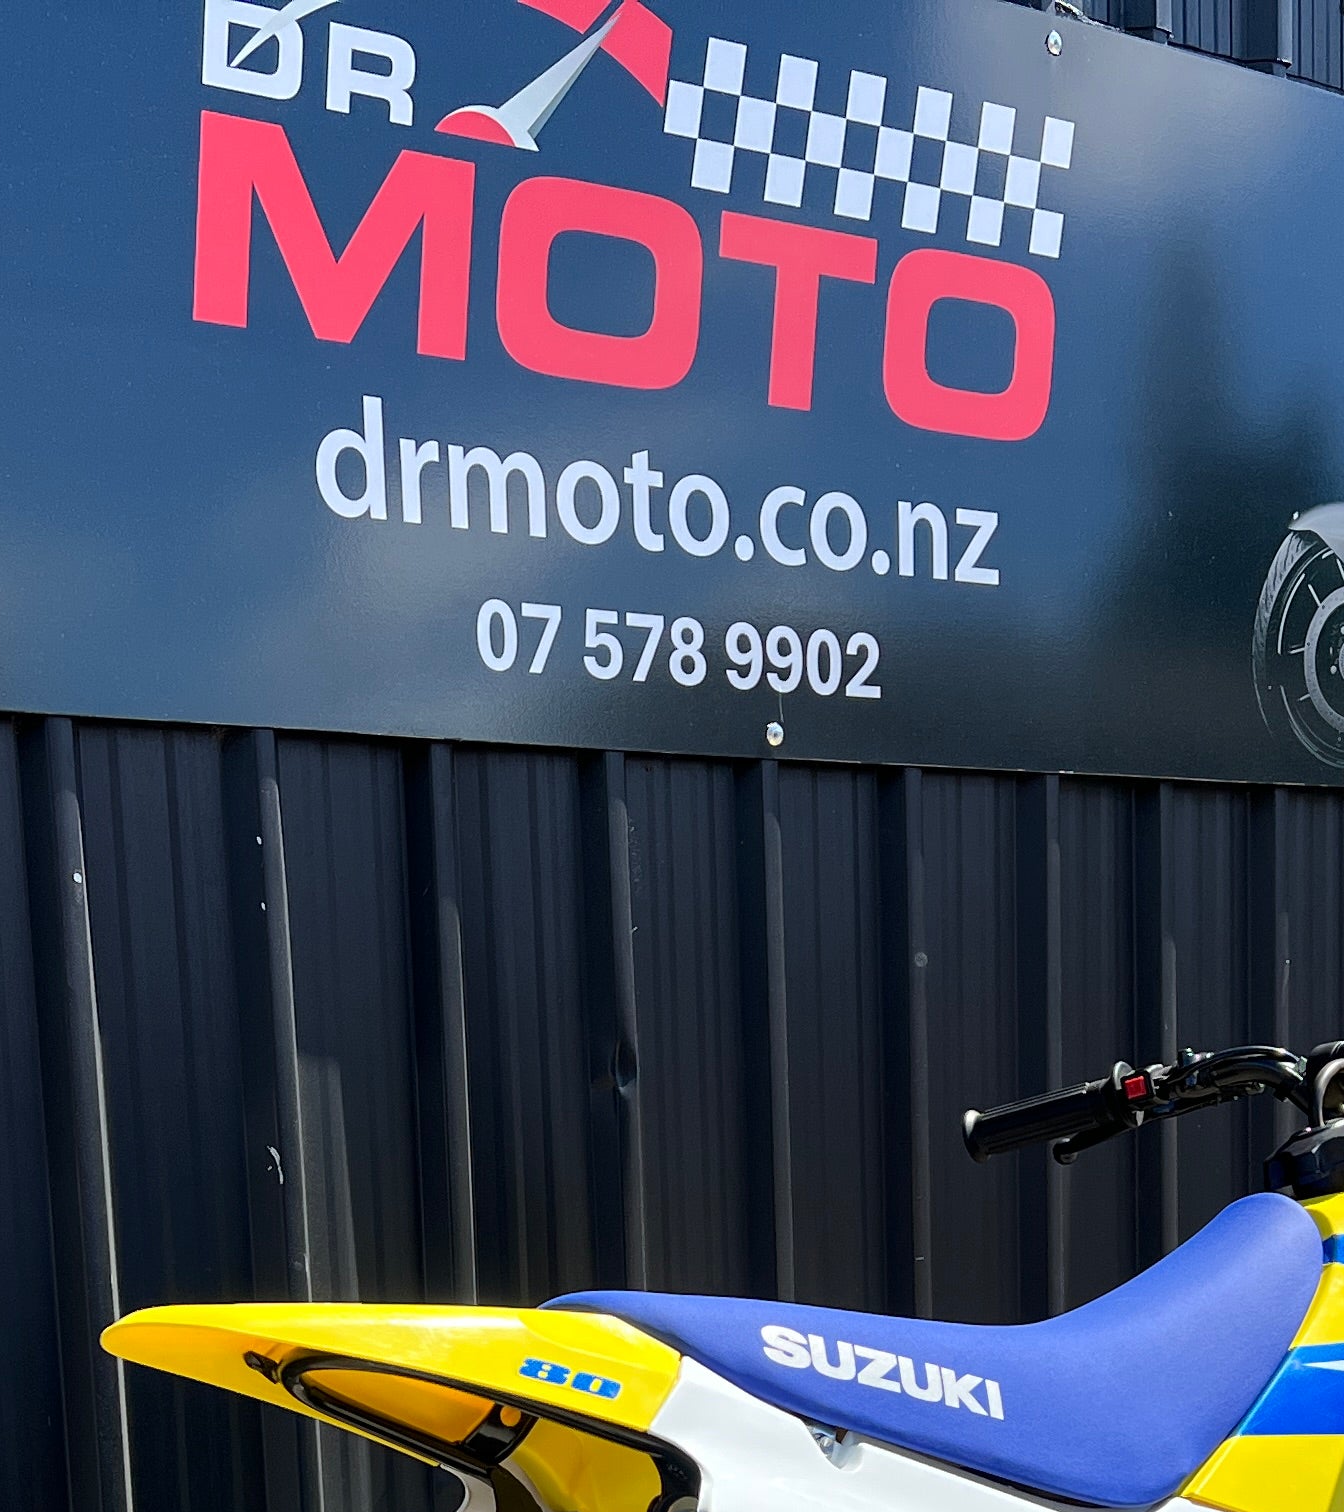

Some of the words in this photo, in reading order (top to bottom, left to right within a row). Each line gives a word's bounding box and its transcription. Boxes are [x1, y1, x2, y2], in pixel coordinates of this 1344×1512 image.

[201, 0, 417, 126] DR
[192, 109, 1056, 442] MOTO
[315, 394, 1001, 586] drmoto.co.nz
[476, 597, 563, 675] 07
[582, 606, 708, 688] 578
[724, 620, 883, 700] 9902
[518, 1356, 622, 1401] 80
[759, 1323, 1005, 1421] SUZUKI
